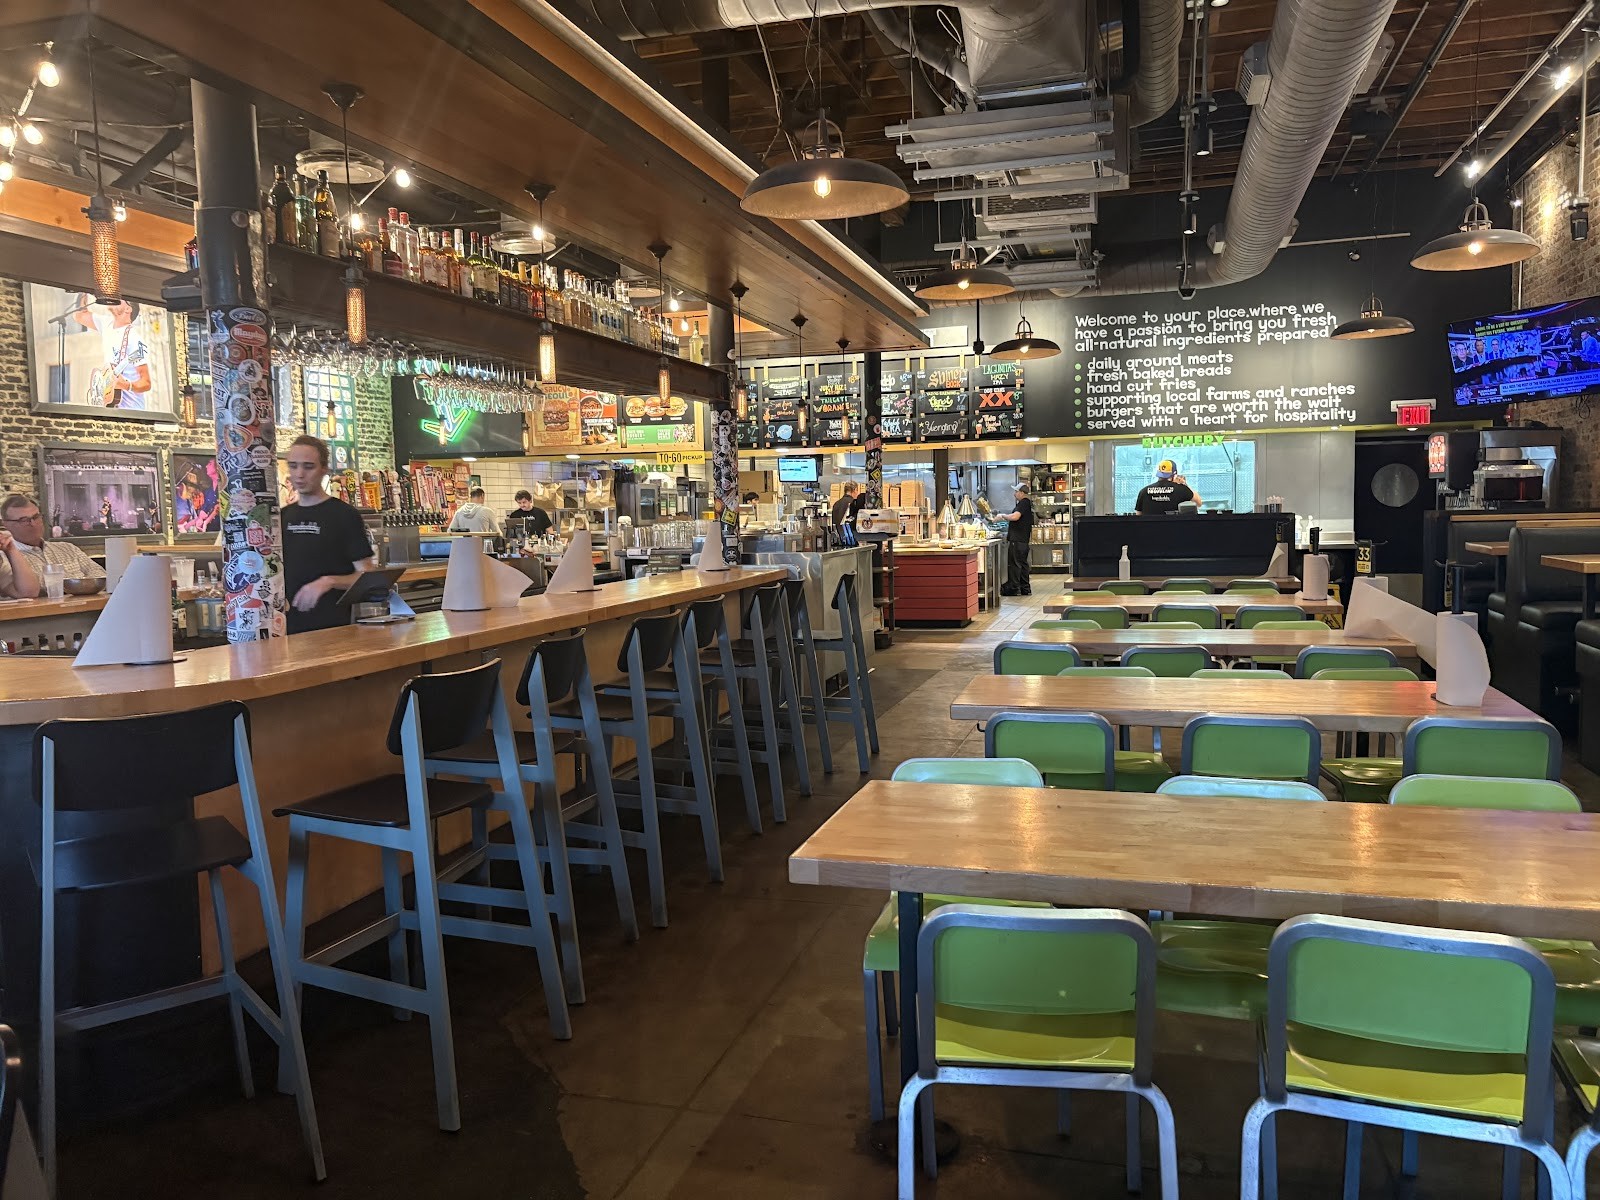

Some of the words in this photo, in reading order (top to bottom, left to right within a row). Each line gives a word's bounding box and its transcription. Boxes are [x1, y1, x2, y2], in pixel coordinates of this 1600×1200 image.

[1075, 314, 1137, 327] Welcome
[1142, 311, 1158, 323] to
[1165, 311, 1201, 325] your
[1302, 302, 1324, 313] we
[1075, 328, 1107, 339] have
[1114, 328, 1122, 337] a
[1128, 323, 1182, 339] passion
[1188, 321, 1206, 333] to
[1213, 318, 1253, 334] bring
[1258, 318, 1286, 332] you
[1075, 335, 1157, 351] all-natural
[1163, 331, 1251, 350] ingredients
[1258, 326, 1329, 345] prepared
[1087, 356, 1121, 371] daily
[1126, 353, 1181, 370] ground
[1188, 350, 1233, 364] meats
[1087, 369, 1127, 382] fresh
[1133, 366, 1174, 379] baked
[1181, 364, 1231, 377] breads
[1087, 381, 1121, 394] hand
[1126, 380, 1153, 392] cut
[1159, 378, 1196, 390] fries
[979, 391, 1014, 408] XX
[1087, 392, 1161, 409] supporting
[1166, 388, 1200, 402] local
[1206, 386, 1250, 400] farms
[1256, 386, 1284, 398] and
[1291, 383, 1355, 397] ranches
[1087, 406, 1143, 419] burgers
[1148, 402, 1183, 415] that
[1190, 403, 1217, 413] are
[1222, 398, 1268, 412] worth
[1274, 397, 1302, 410] the
[1308, 395, 1341, 408] wait
[1402, 406, 1427, 425] EXIT
[1087, 416, 1135, 430] served
[1141, 415, 1173, 427] with
[1180, 416, 1188, 426] a
[1195, 412, 1237, 425] heart
[1243, 410, 1268, 423] for
[1274, 408, 1356, 423] hospitality
[1142, 435, 1224, 448] BUTCHERY
[659, 453, 682, 463] TO-GO
[633, 464, 676, 474] BAKERY
[1358, 547, 1371, 561] 33
